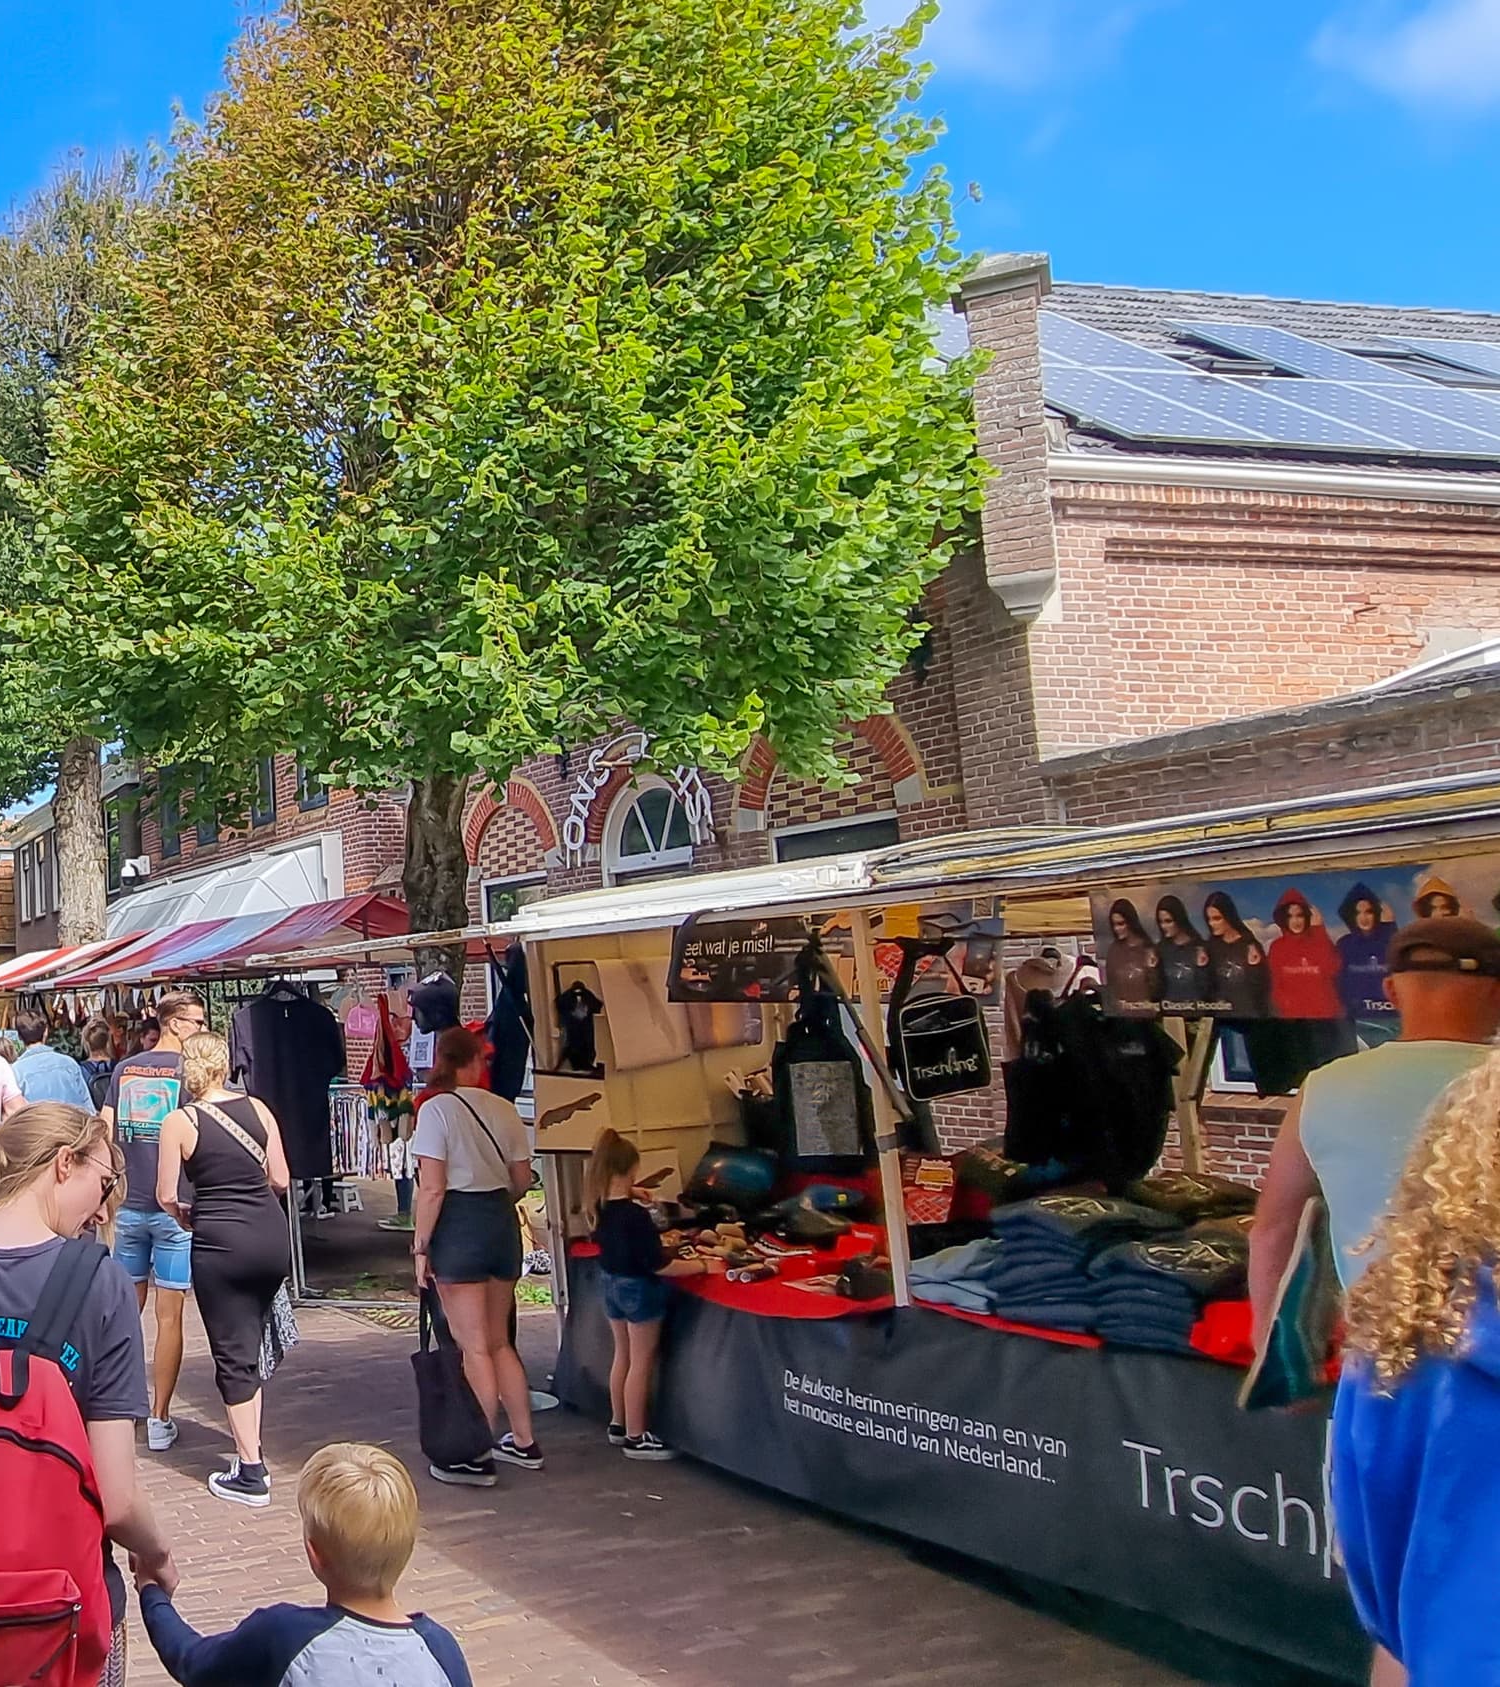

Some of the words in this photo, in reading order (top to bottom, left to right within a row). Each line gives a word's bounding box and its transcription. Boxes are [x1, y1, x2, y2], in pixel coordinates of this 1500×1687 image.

[705, 938, 726, 956] wat
[726, 936, 740, 959] je
[742, 934, 773, 954] mist!
[784, 1369, 799, 1391] De
[800, 1374, 843, 1404] leukste
[845, 1387, 959, 1432] herinneringen
[963, 1418, 997, 1441] aan
[1003, 1427, 1027, 1448] en
[1031, 1432, 1068, 1457] van
[784, 1394, 800, 1416] het
[802, 1402, 853, 1433] mooiste
[855, 1416, 907, 1446] eiland
[911, 1431, 939, 1455] van
